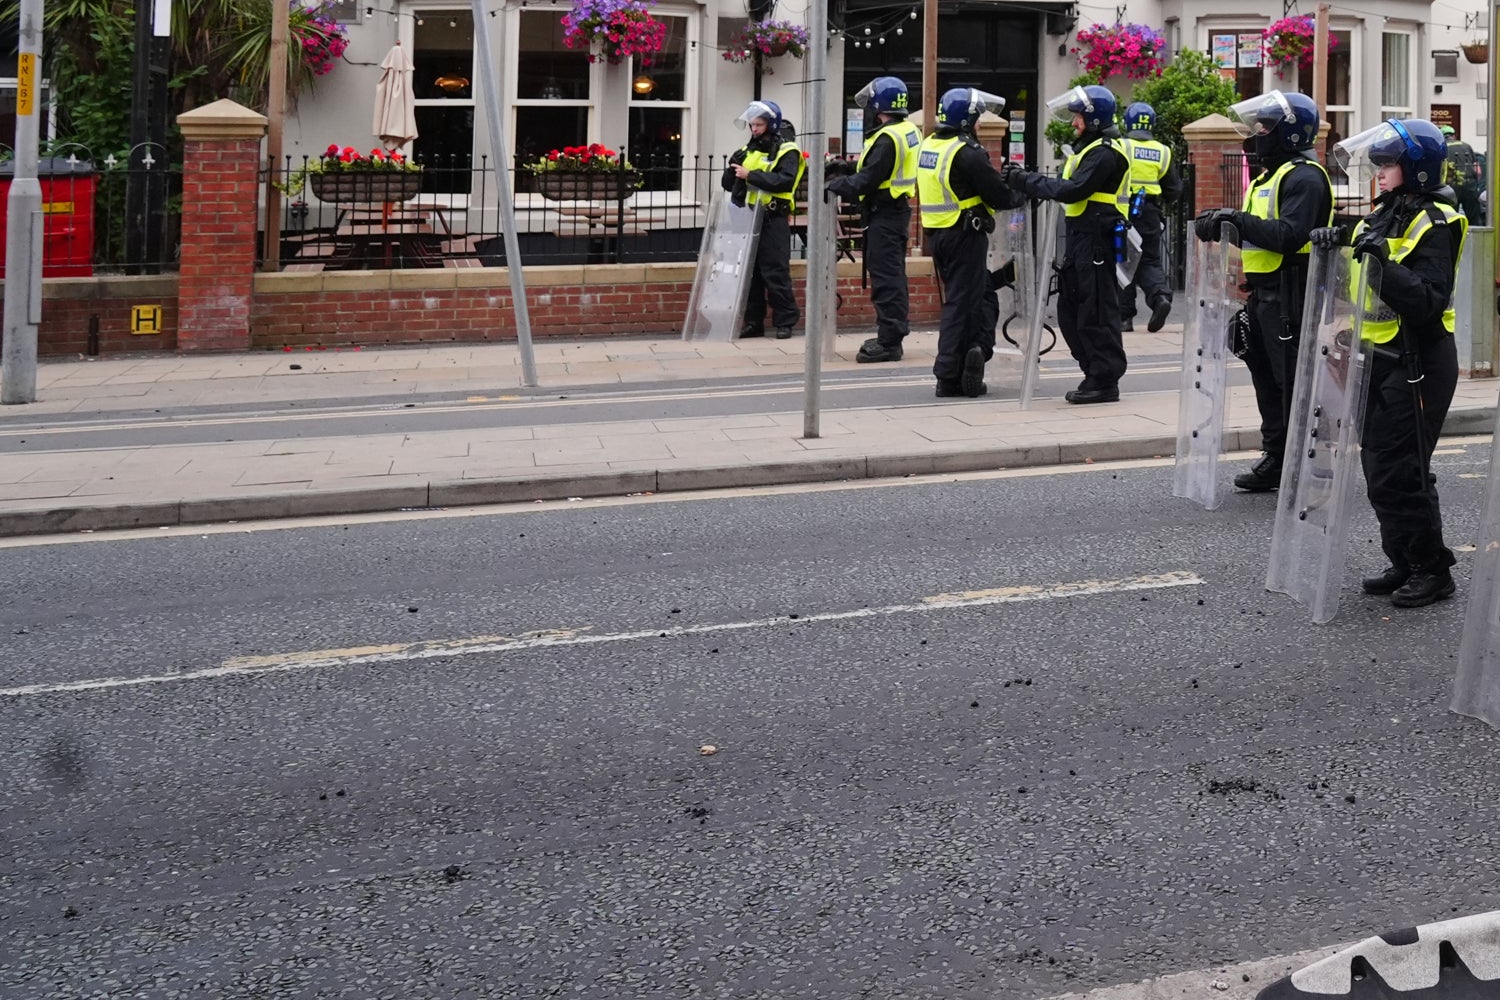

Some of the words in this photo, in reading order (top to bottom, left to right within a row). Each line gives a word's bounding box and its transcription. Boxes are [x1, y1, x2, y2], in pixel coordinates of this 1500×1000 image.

[1139, 114, 1150, 123] LZ
[1135, 148, 1160, 160] POLICE
[136, 308, 157, 331] H
